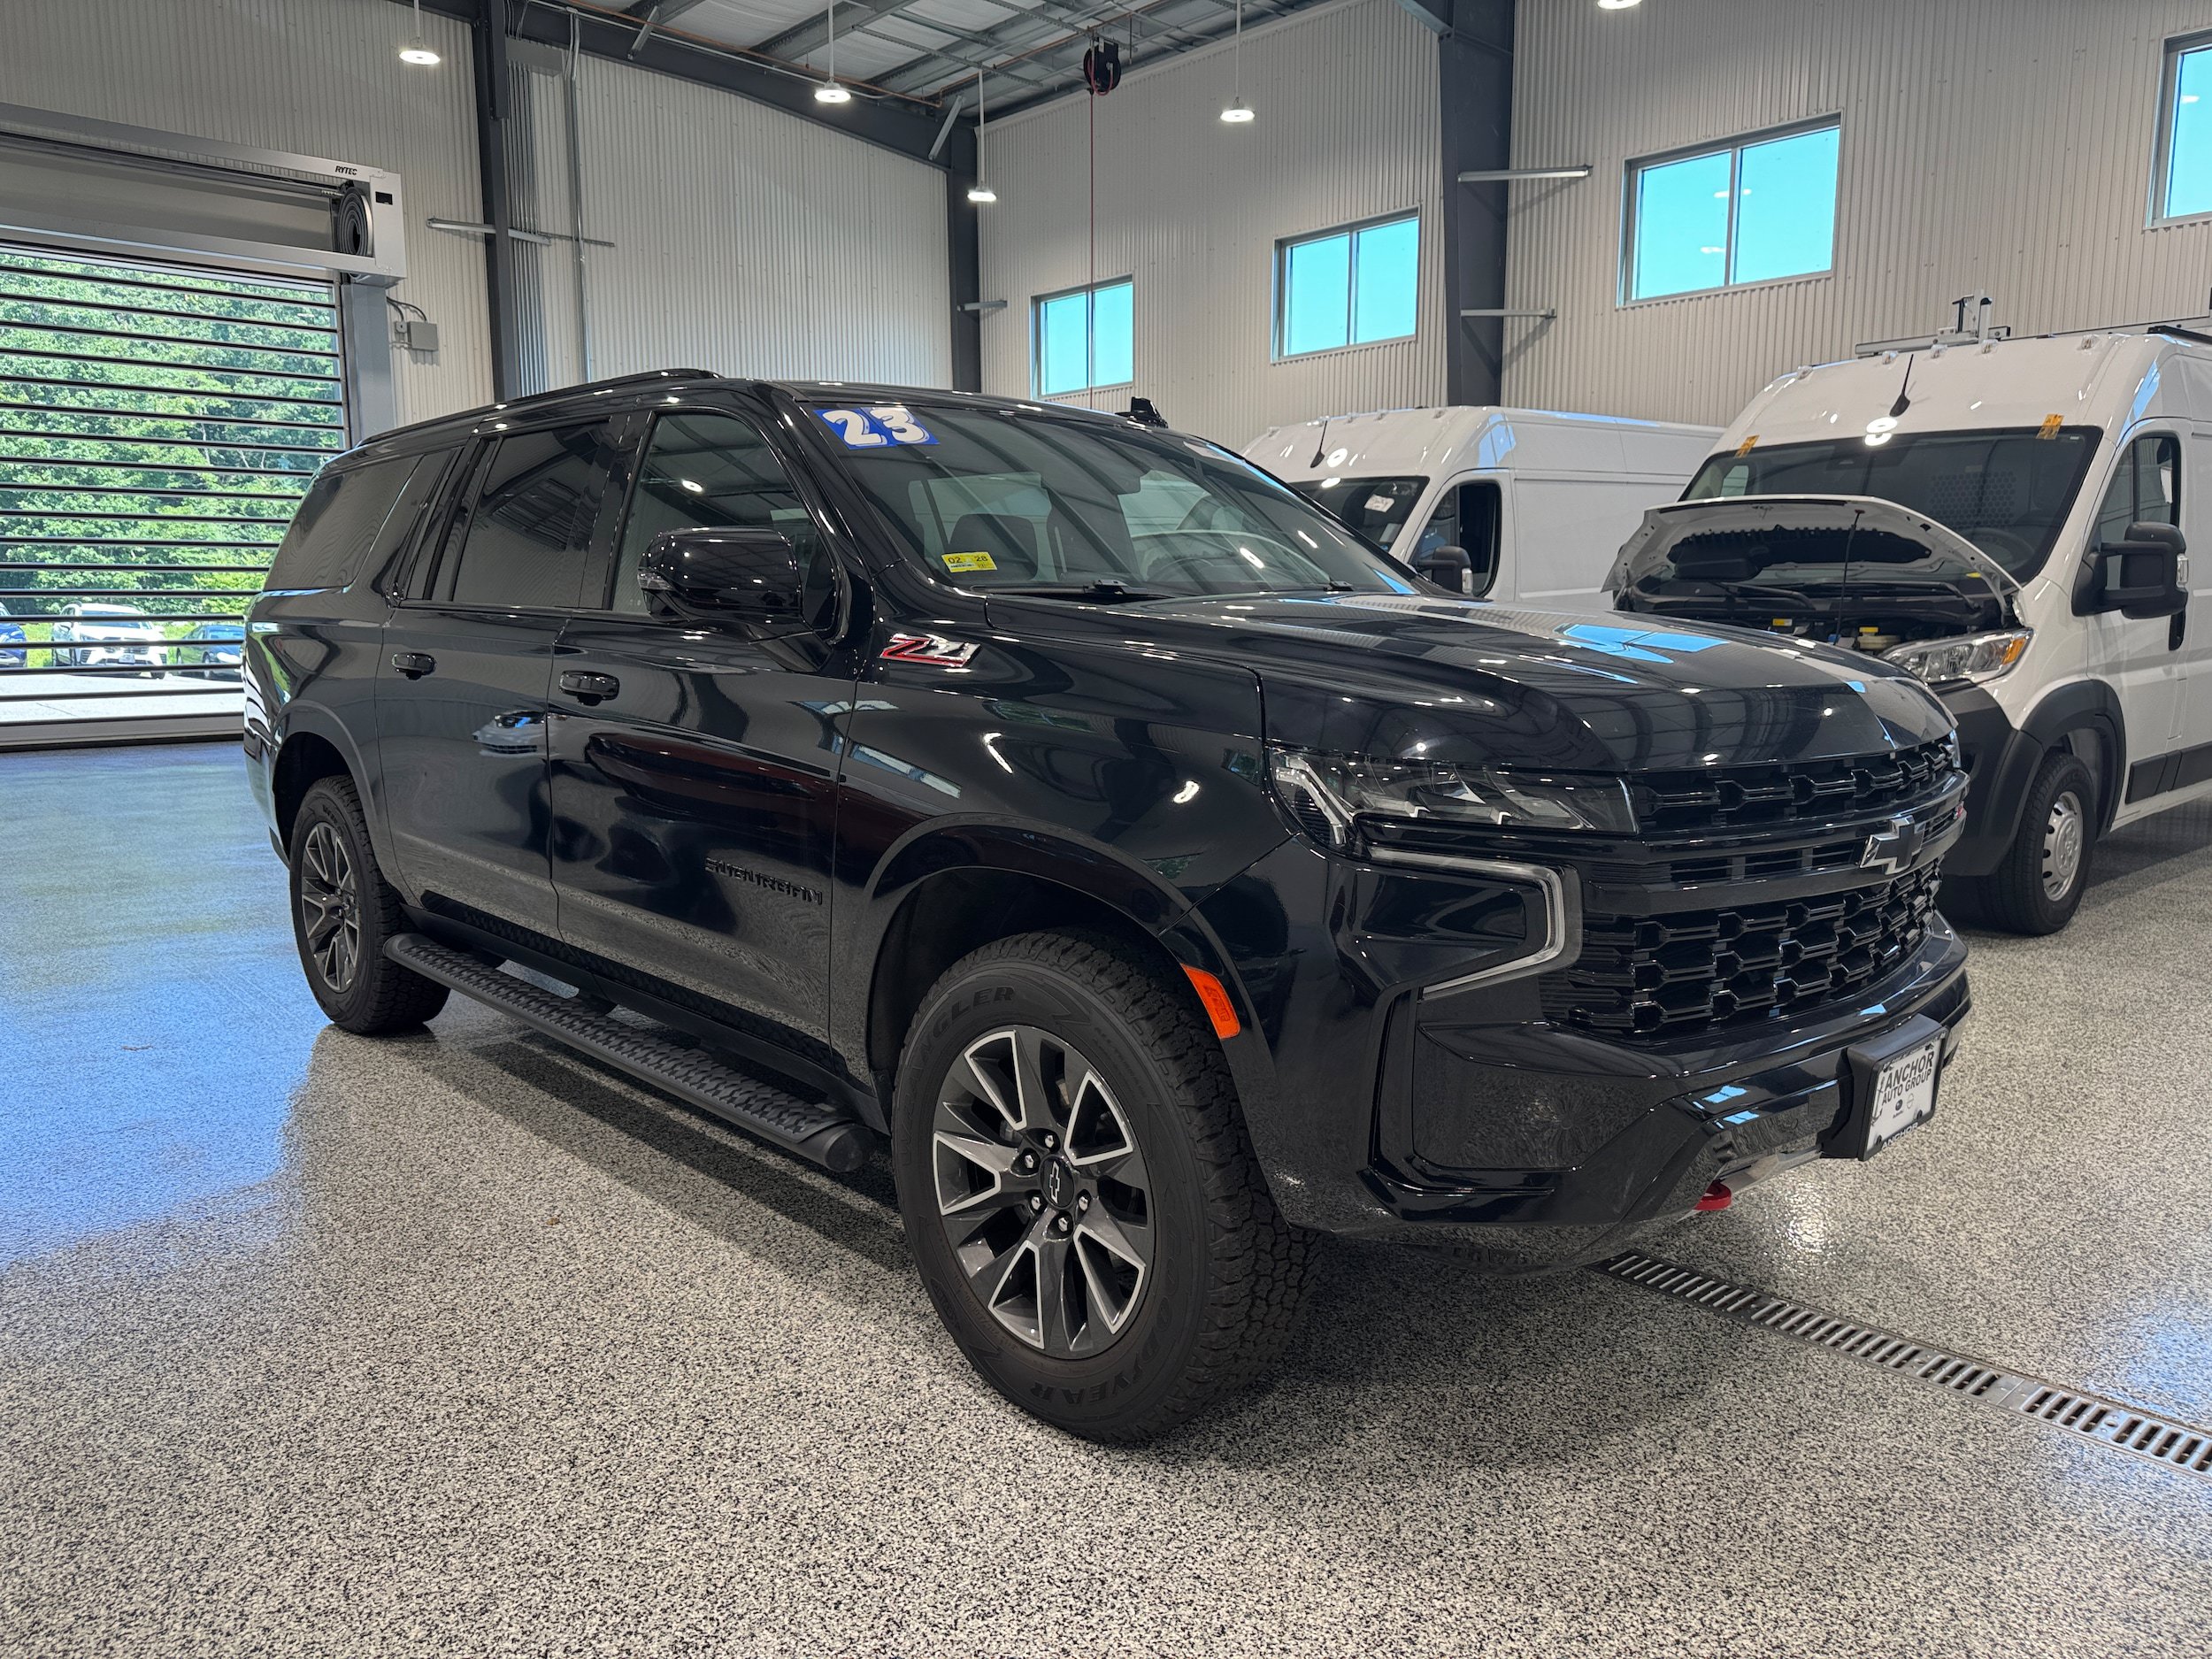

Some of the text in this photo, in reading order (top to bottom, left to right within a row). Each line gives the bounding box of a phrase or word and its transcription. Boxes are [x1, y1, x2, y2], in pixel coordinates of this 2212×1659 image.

[334, 165, 358, 176] RYTEC
[822, 407, 930, 446] 23
[879, 633, 981, 668] Z71
[1881, 1068, 1932, 1106] AUTO GROUP
[1885, 1050, 1935, 1091] ANCHOR
[1881, 1122, 1919, 1150] ANCHOR
